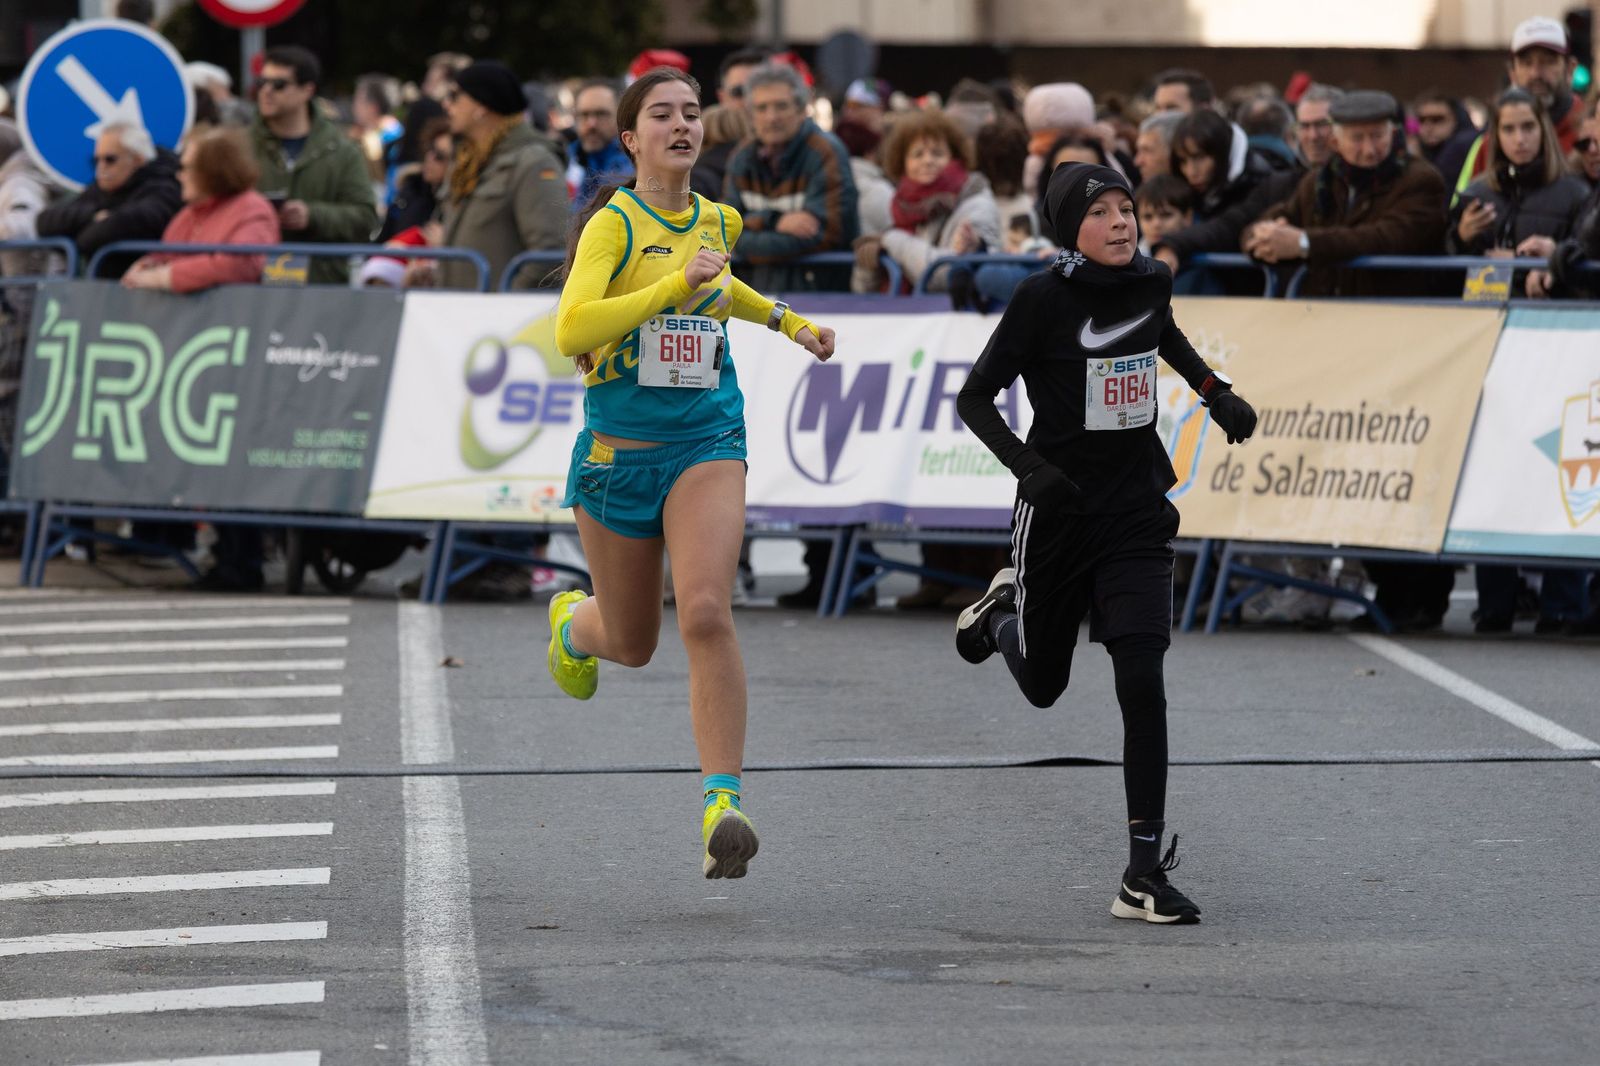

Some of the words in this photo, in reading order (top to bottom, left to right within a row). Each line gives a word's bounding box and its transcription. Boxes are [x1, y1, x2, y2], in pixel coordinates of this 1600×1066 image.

[666, 317, 718, 332] SETEL
[660, 334, 702, 363] 6191
[1114, 354, 1157, 373] SETEL
[1104, 372, 1149, 405] 6164
[1253, 401, 1431, 444] untamiento
[1210, 453, 1245, 493] de
[1252, 452, 1416, 503] Salamanca
